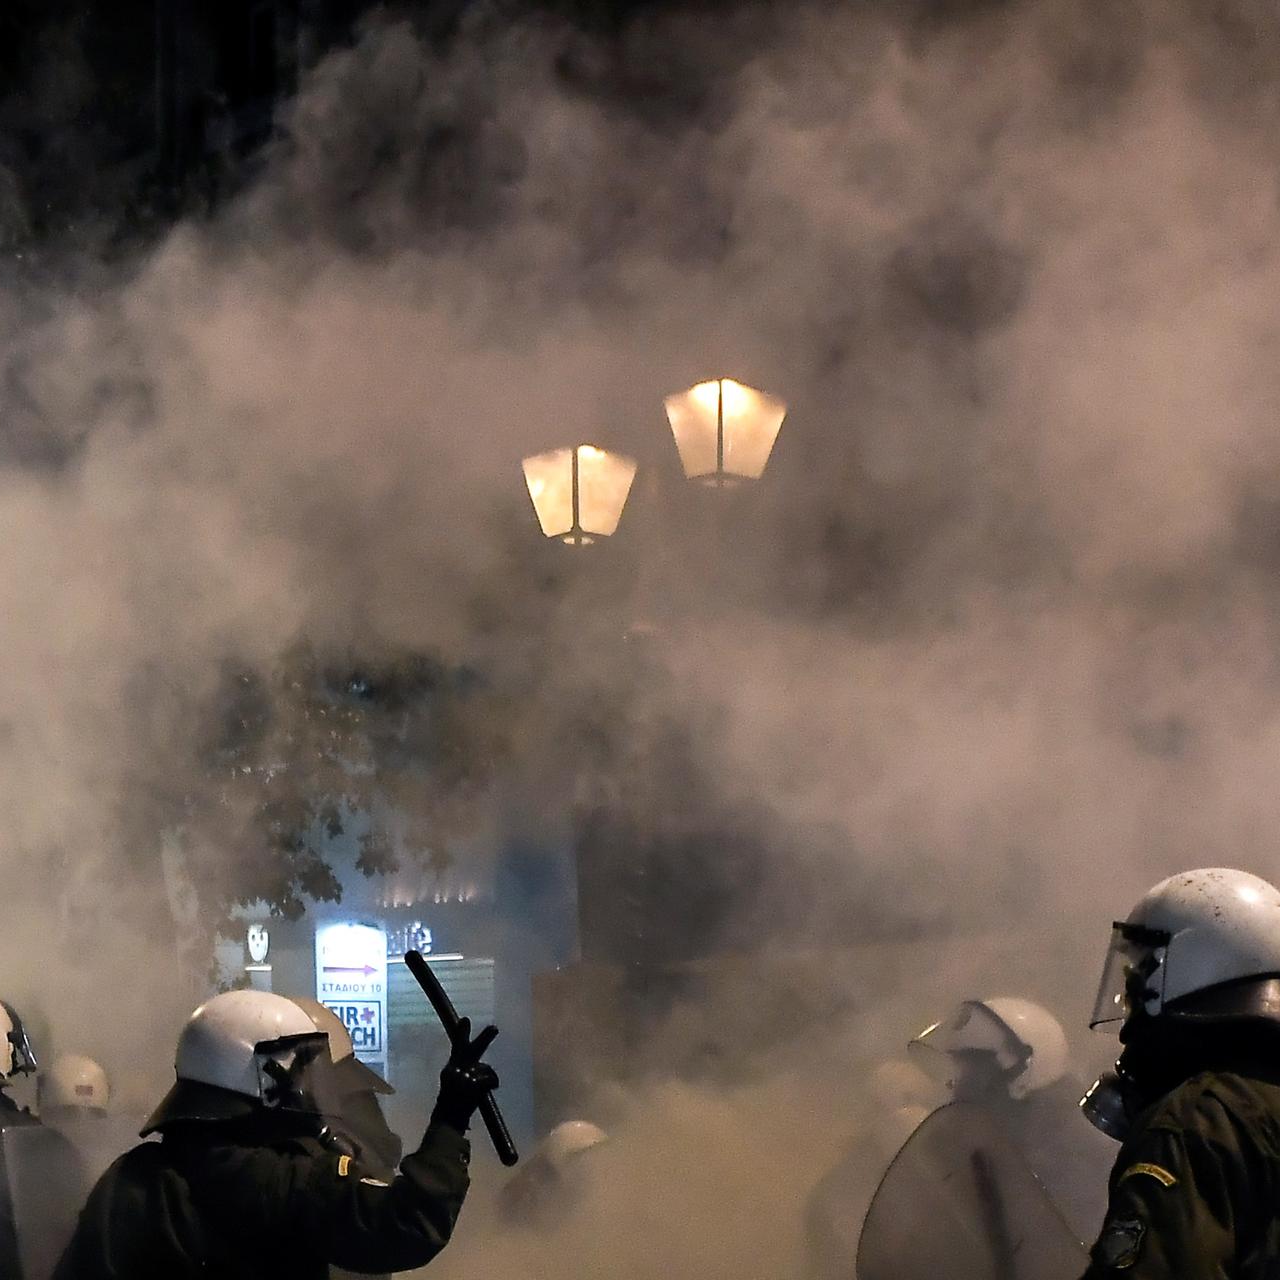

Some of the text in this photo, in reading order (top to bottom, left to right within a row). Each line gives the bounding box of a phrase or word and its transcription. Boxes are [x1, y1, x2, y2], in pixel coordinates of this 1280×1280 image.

[322, 983, 382, 992] ΣΤΑΔΙΟΥ 10
[349, 1027, 376, 1046] CH
